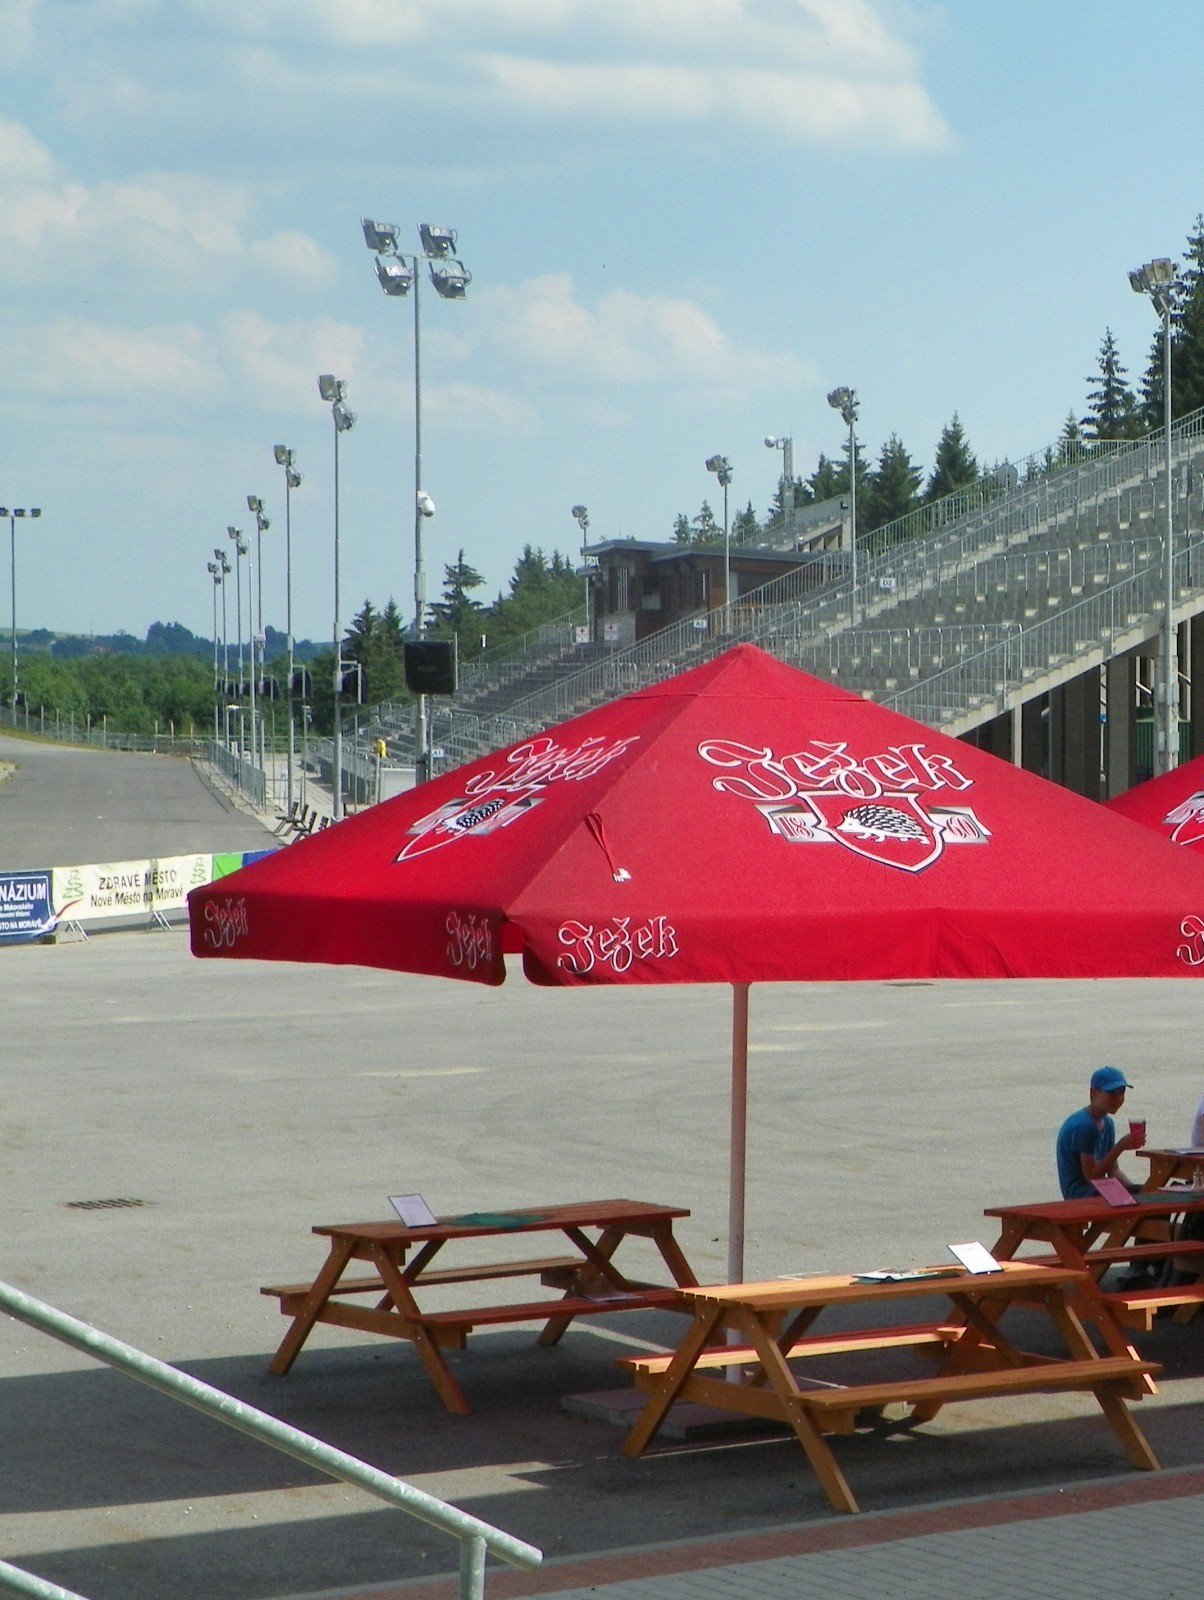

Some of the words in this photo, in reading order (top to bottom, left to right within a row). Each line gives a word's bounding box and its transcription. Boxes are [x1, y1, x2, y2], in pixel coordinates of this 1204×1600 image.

[697, 739, 974, 801] Ježek
[91, 891, 112, 907] Nové
[143, 891, 153, 904] na
[99, 871, 141, 890] ZDRAVÉ
[144, 868, 177, 886] MĚSTO
[557, 916, 679, 974] Ježek
